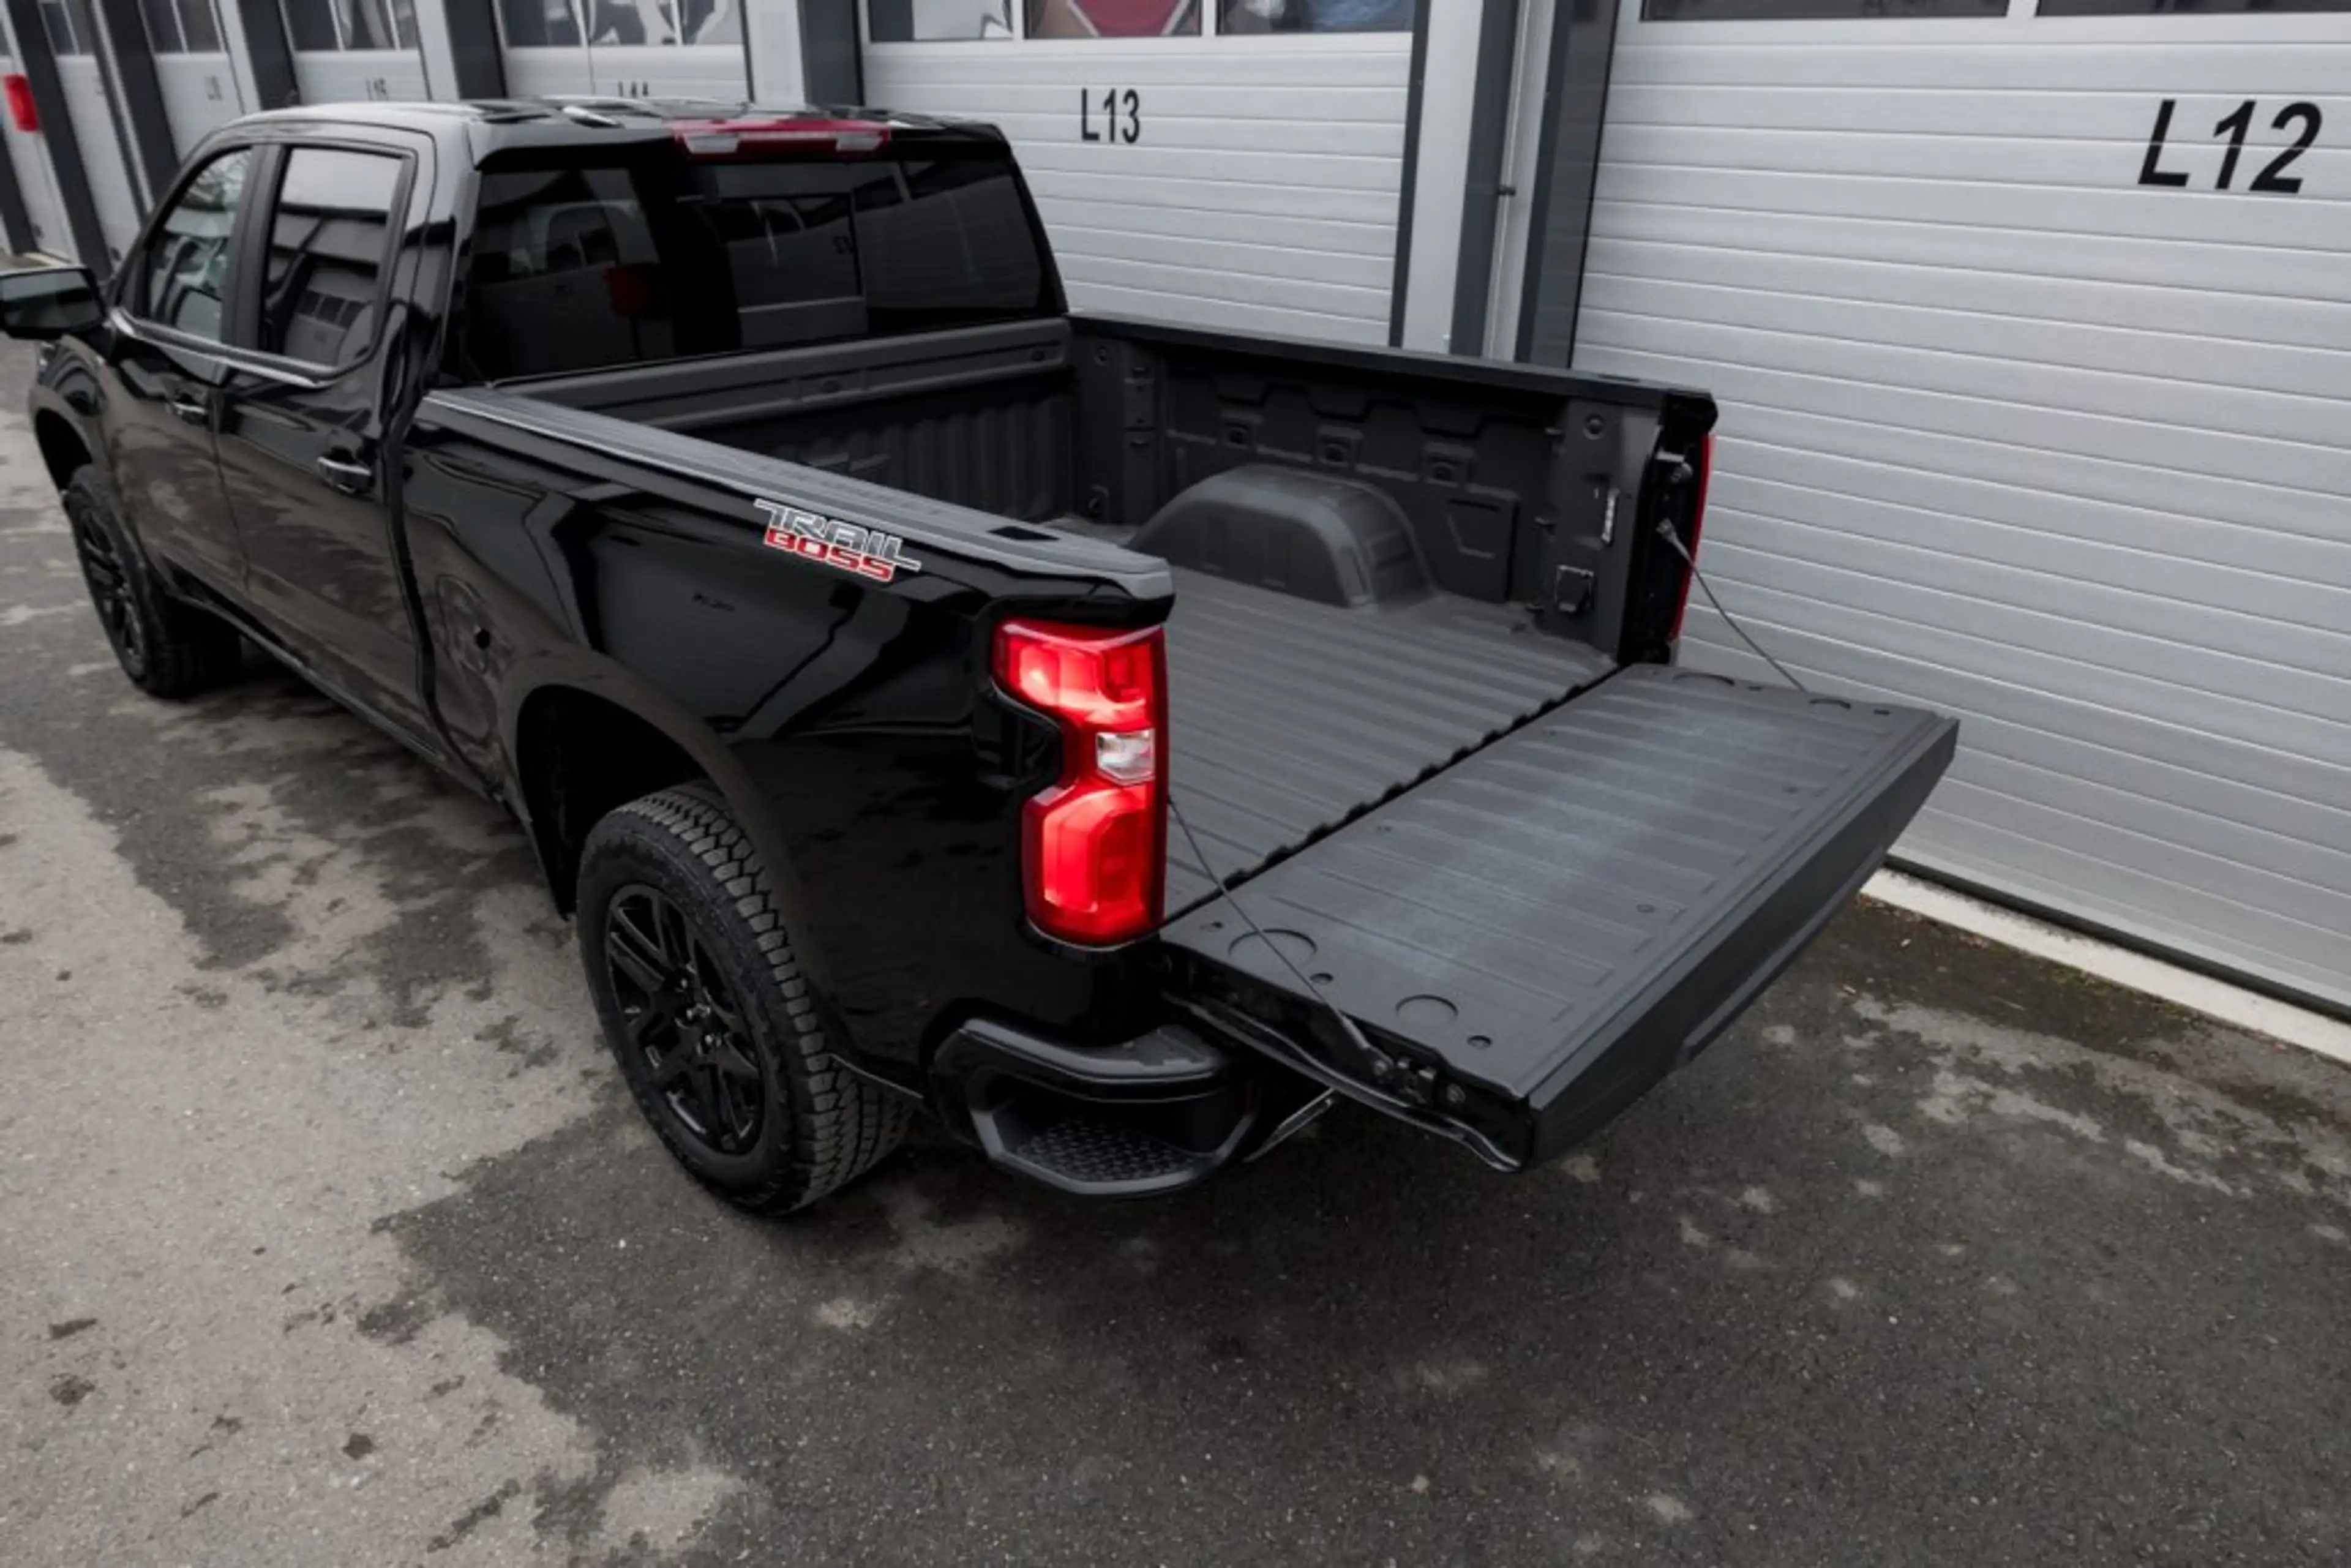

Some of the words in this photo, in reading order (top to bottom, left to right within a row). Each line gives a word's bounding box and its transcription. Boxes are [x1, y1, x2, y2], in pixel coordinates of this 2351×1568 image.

[1081, 87, 1140, 144] L13
[2137, 99, 2323, 193] L12
[753, 498, 921, 572] TRAIL
[763, 526, 896, 582] BOSS
